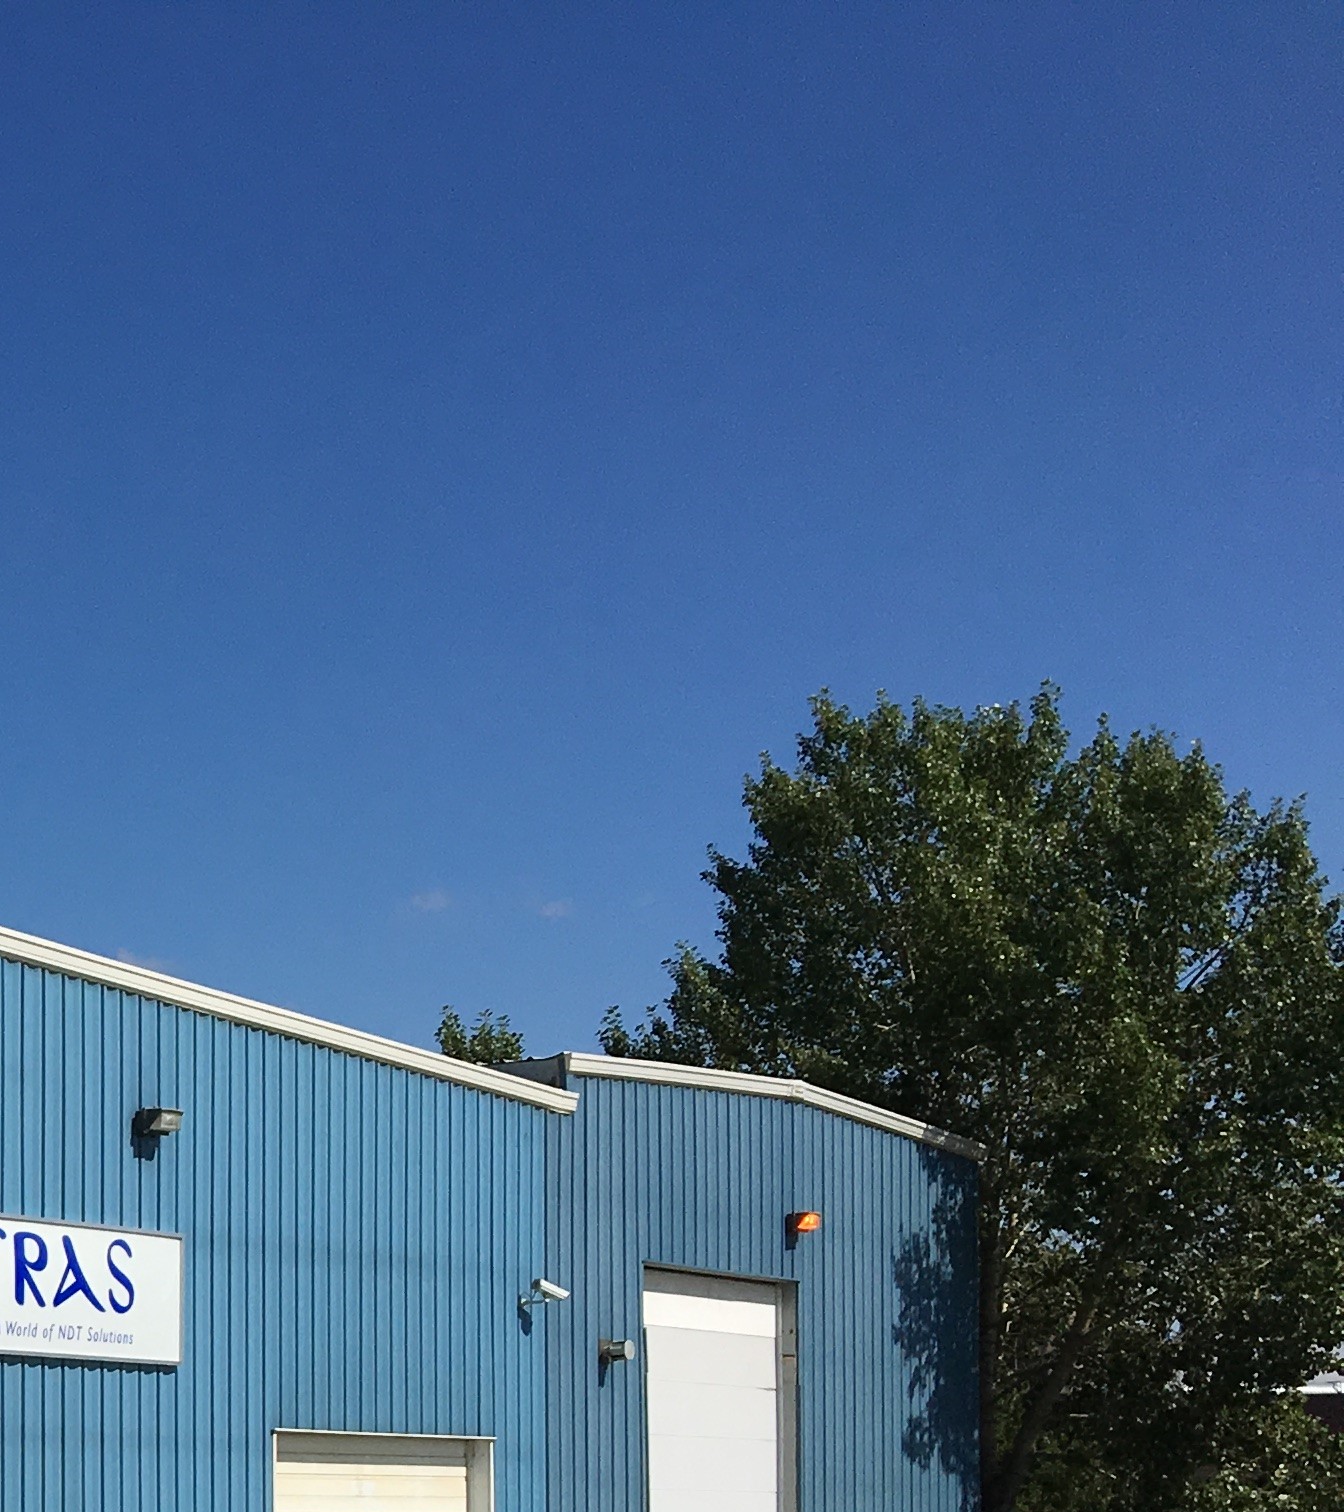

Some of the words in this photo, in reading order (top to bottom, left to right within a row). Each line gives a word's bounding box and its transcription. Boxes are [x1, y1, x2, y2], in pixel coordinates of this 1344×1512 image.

[5, 1320, 37, 1338] World
[43, 1323, 53, 1342] of
[58, 1325, 81, 1341] NDT
[87, 1327, 134, 1345] Solutions
